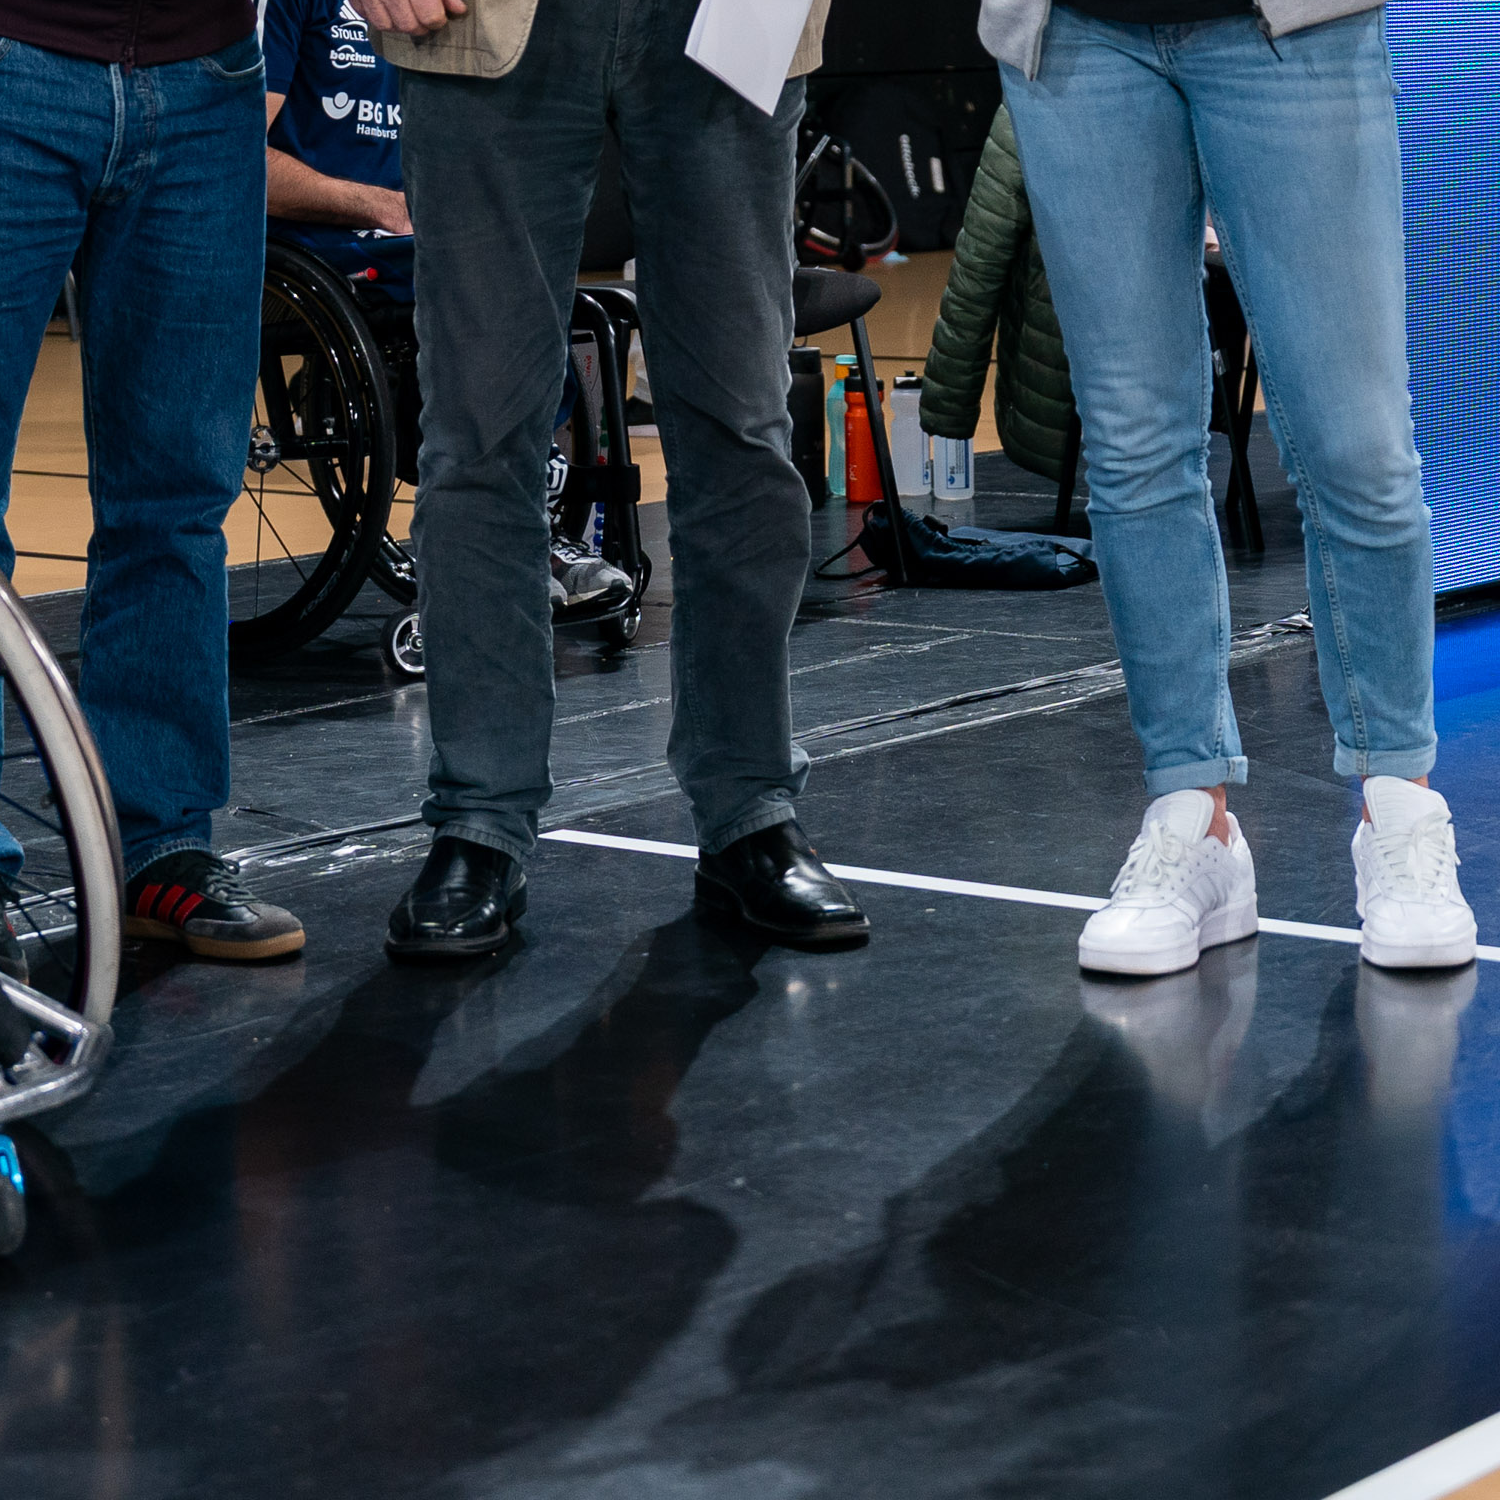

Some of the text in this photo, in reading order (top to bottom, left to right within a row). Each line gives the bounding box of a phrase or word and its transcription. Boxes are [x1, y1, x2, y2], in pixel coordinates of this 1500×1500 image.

[329, 49, 376, 64] borchers
[358, 99, 383, 125] BG
[356, 123, 398, 140] Hamburg
